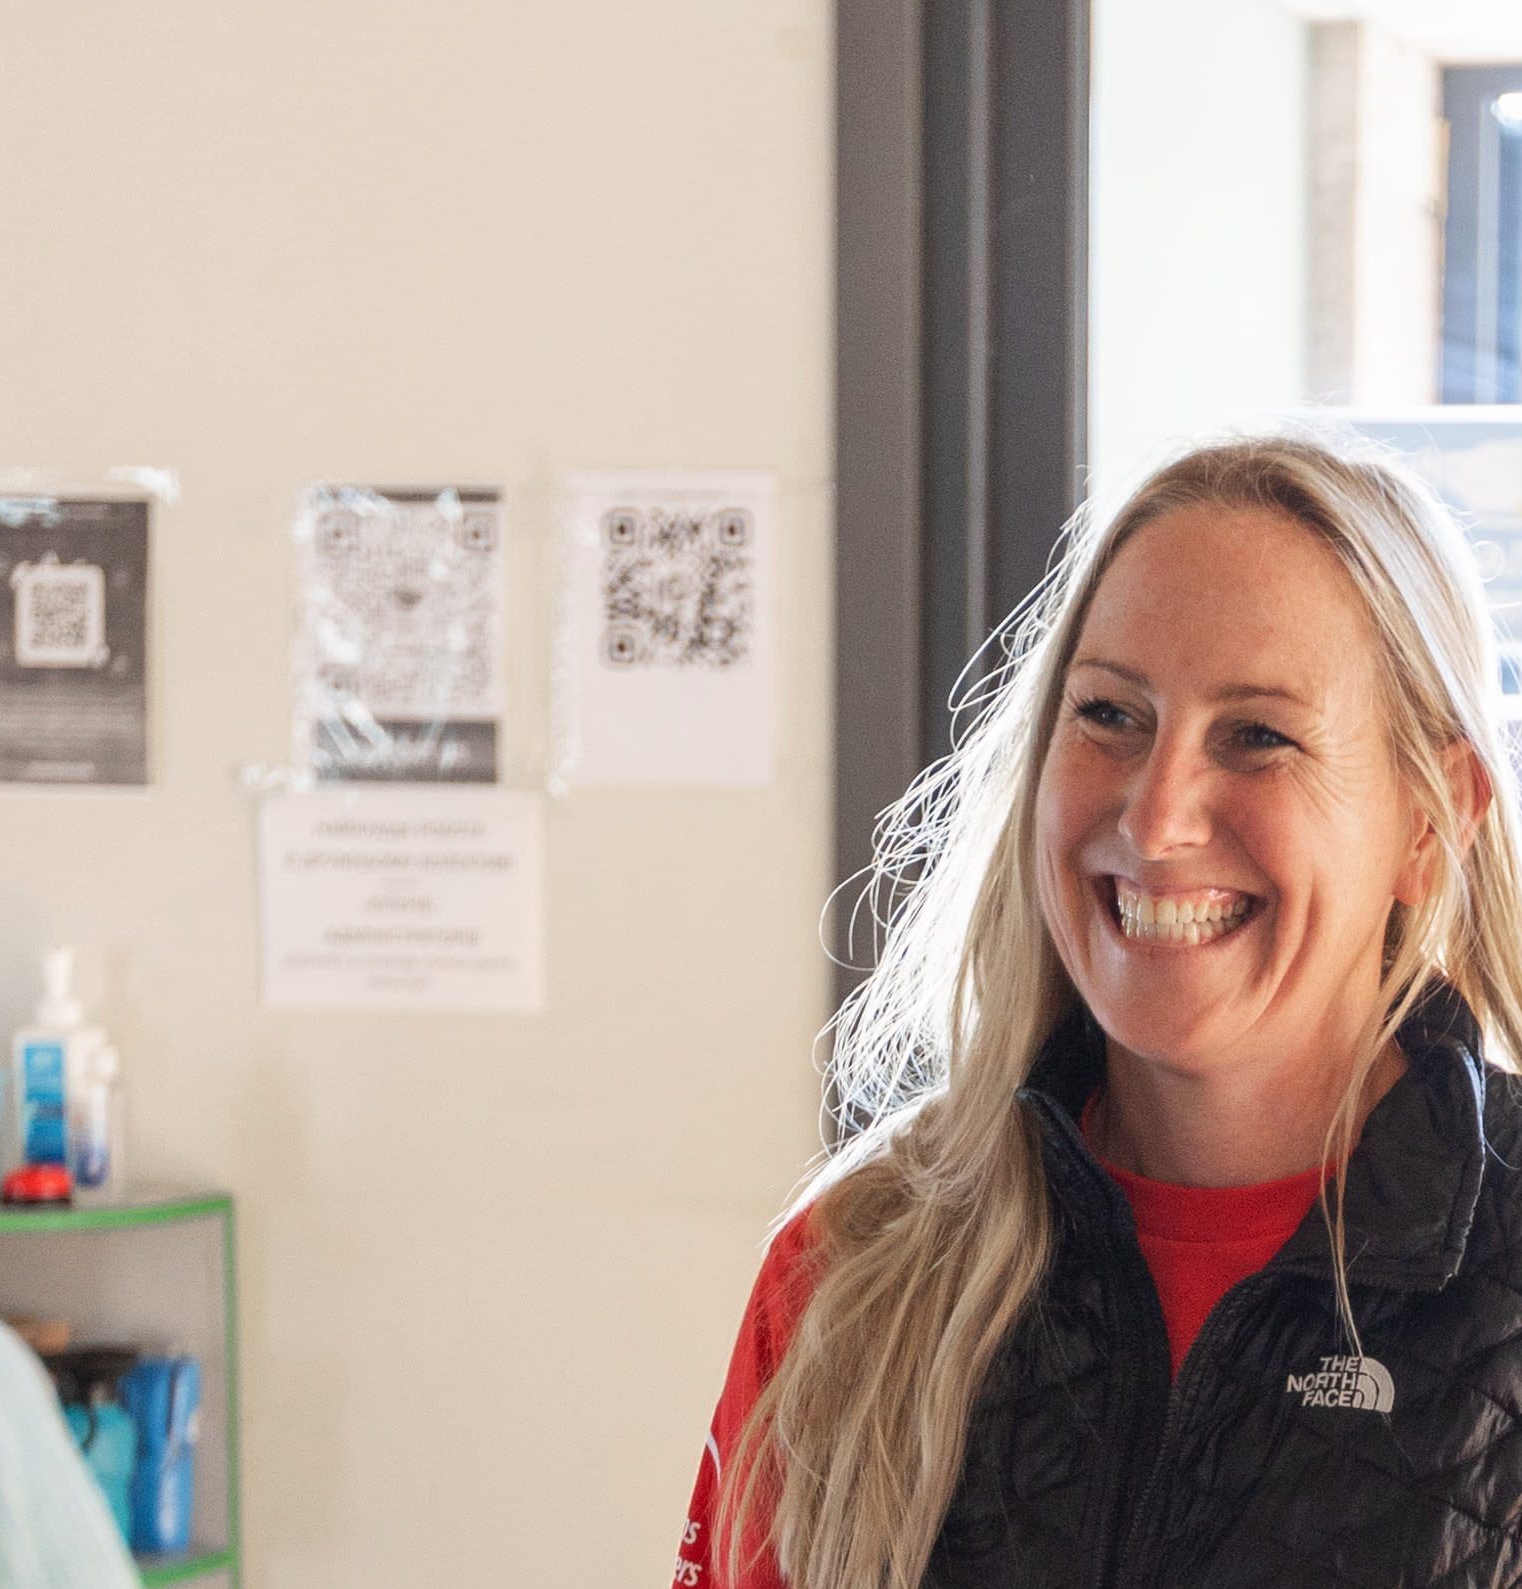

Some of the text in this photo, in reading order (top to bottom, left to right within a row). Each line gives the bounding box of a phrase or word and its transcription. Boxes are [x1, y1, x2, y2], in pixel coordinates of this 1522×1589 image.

[1320, 1355, 1359, 1371] THE
[1286, 1372, 1356, 1392] NORTH
[1302, 1389, 1352, 1407] FACE
